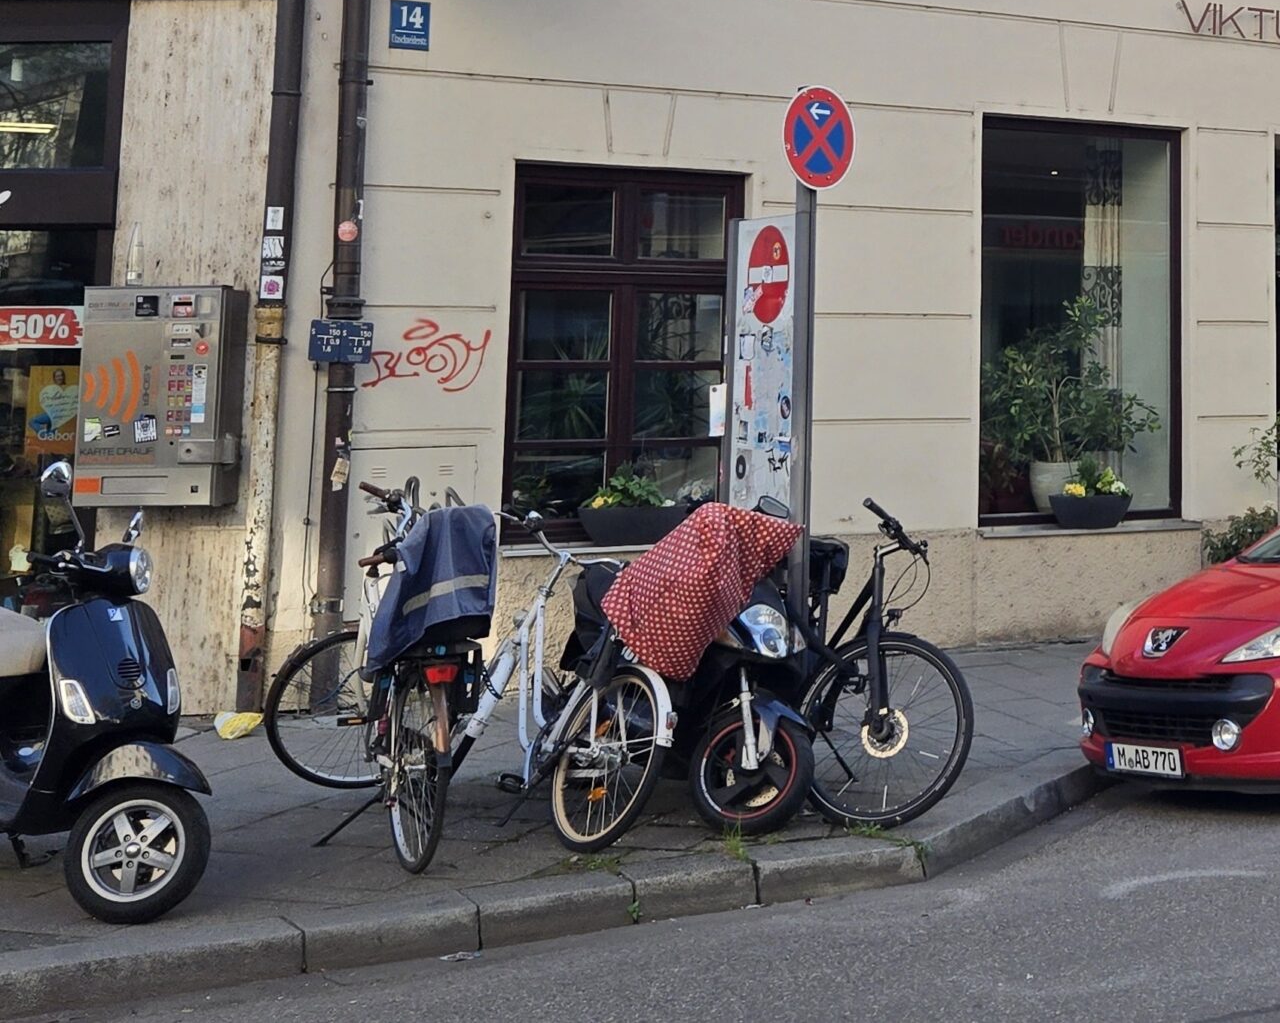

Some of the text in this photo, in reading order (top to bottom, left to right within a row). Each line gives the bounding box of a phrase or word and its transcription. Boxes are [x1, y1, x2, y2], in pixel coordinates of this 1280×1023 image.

[400, 5, 424, 29] 14
[0, 313, 70, 340] -50%
[360, 330, 372, 338] 150
[37, 428, 75, 442] Gabor
[80, 447, 114, 457] KARTE
[1117, 746, 1177, 771] M AB 770
